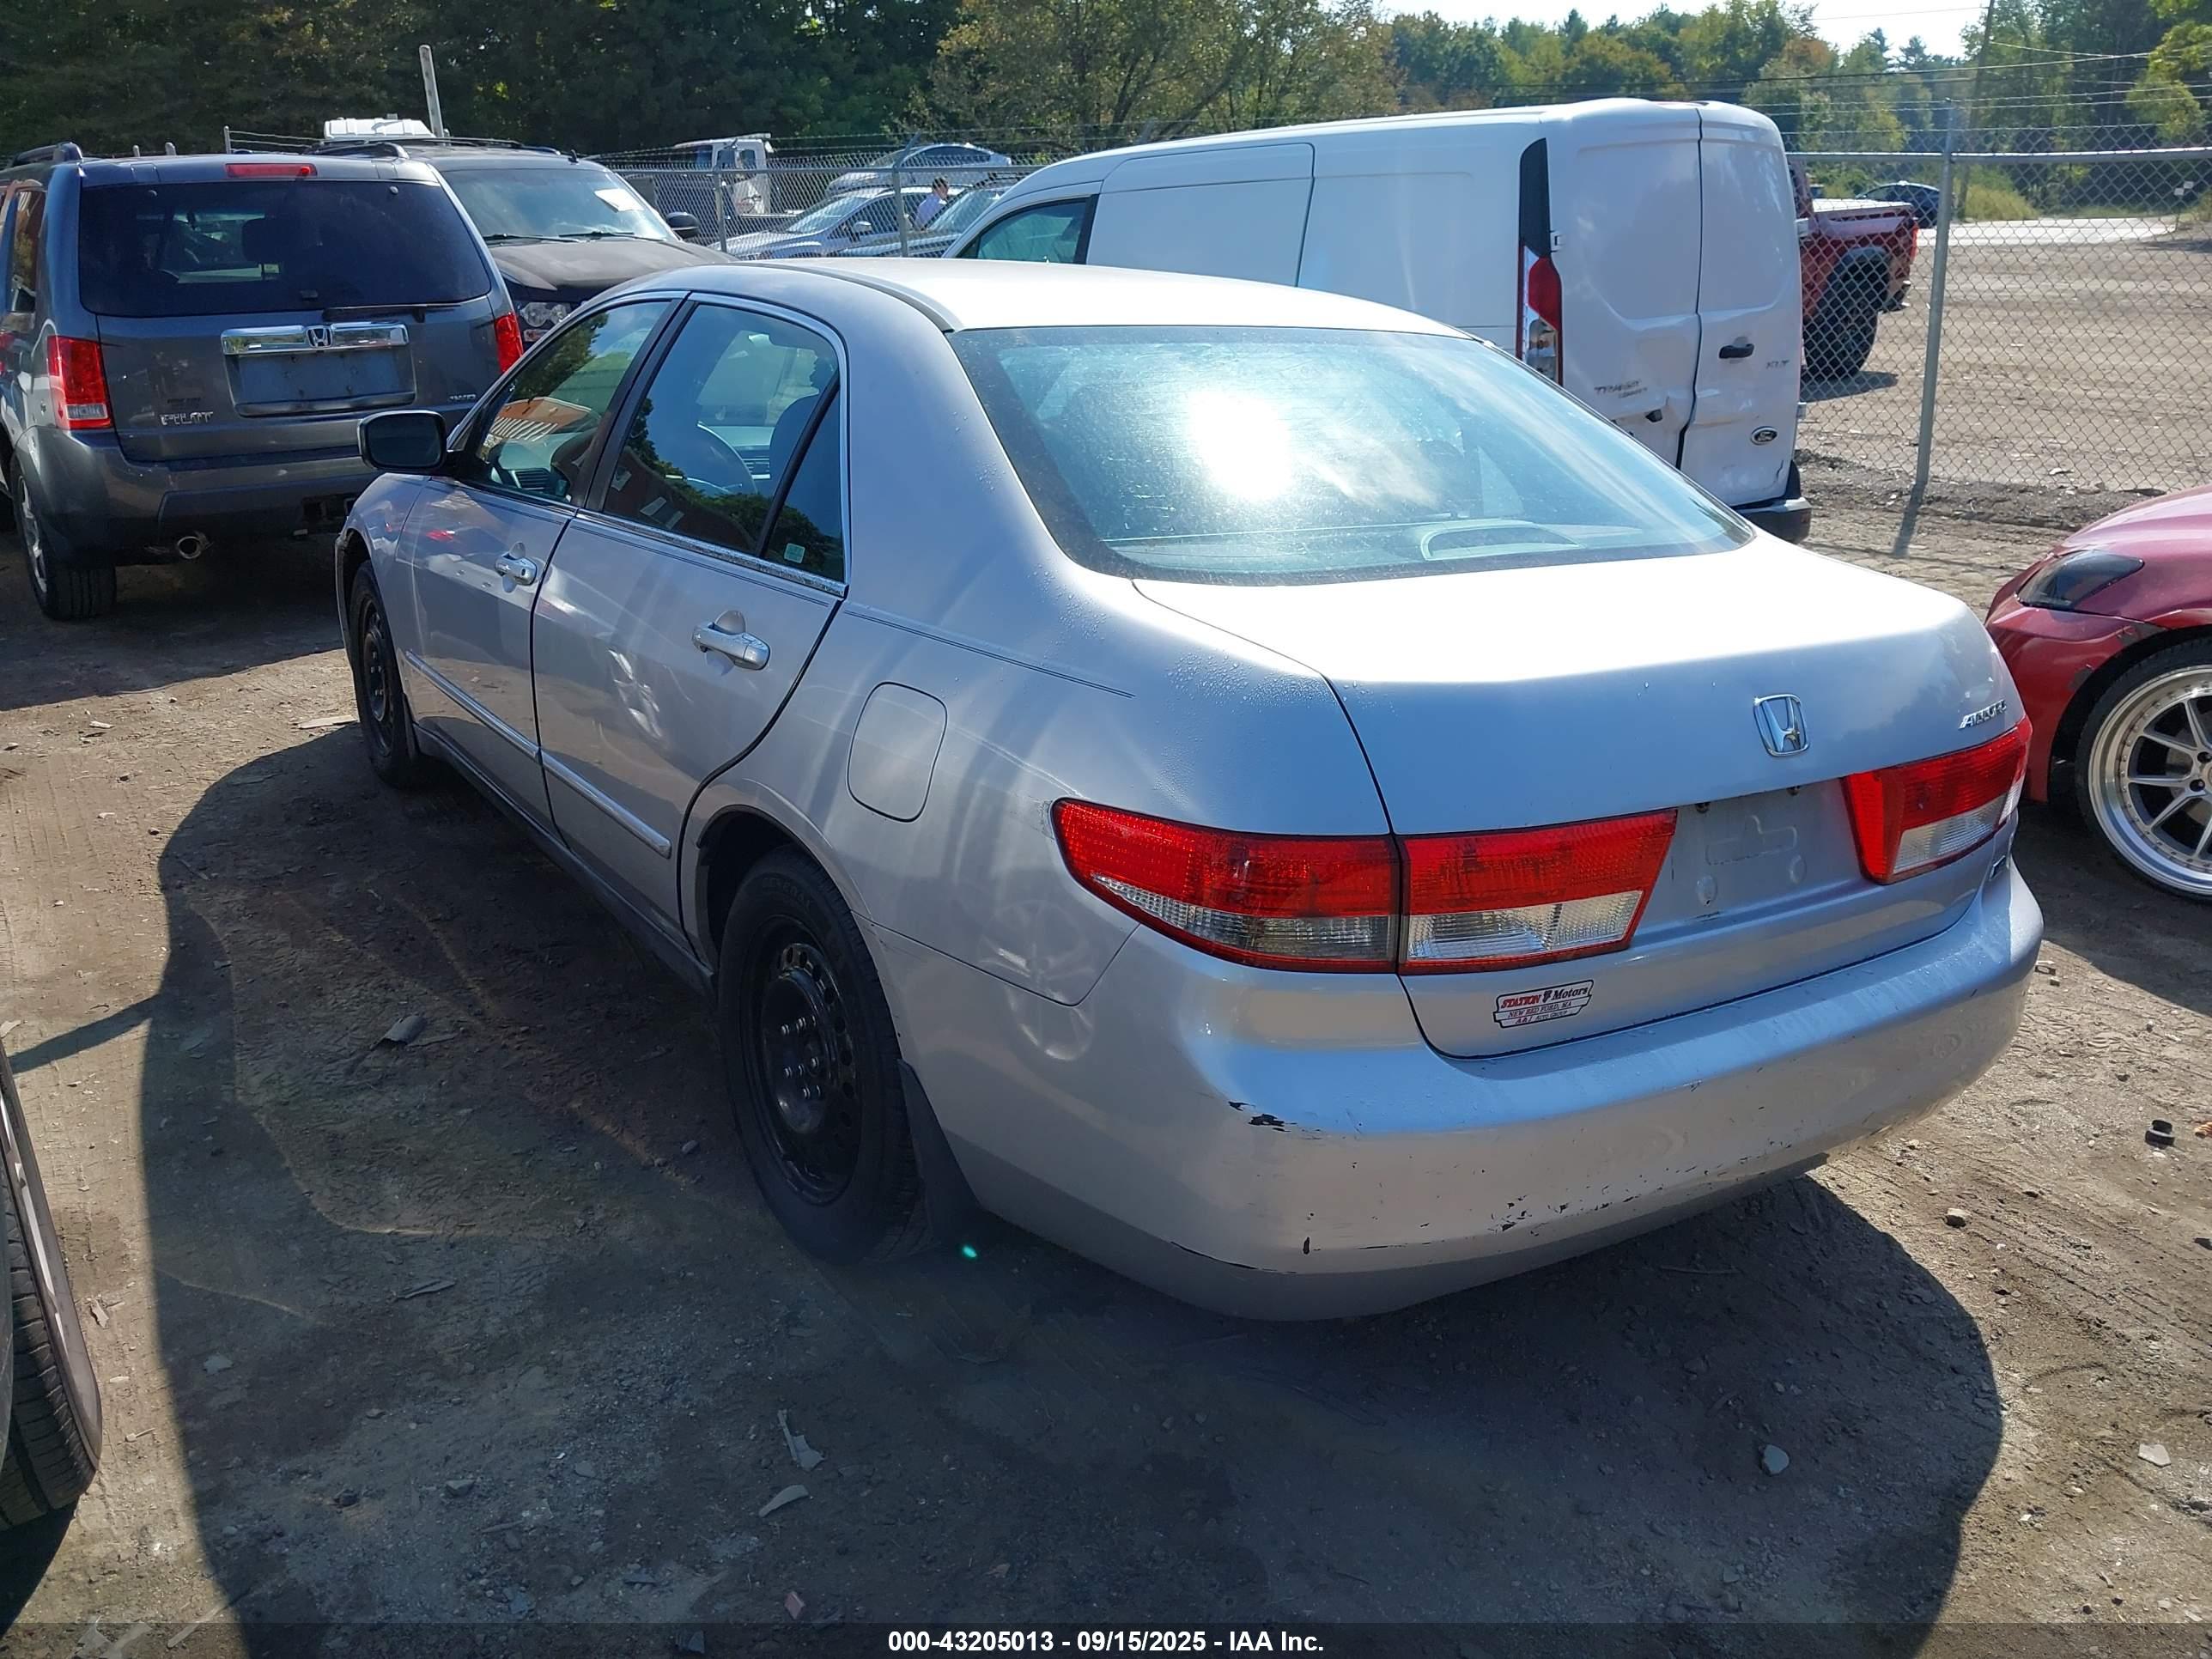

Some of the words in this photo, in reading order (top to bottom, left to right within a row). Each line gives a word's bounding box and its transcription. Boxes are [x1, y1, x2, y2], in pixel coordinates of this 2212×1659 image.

[1501, 994, 1542, 1009] STATION
[1551, 987, 1589, 1000] Motors
[1508, 1009, 1525, 1018] NEW
